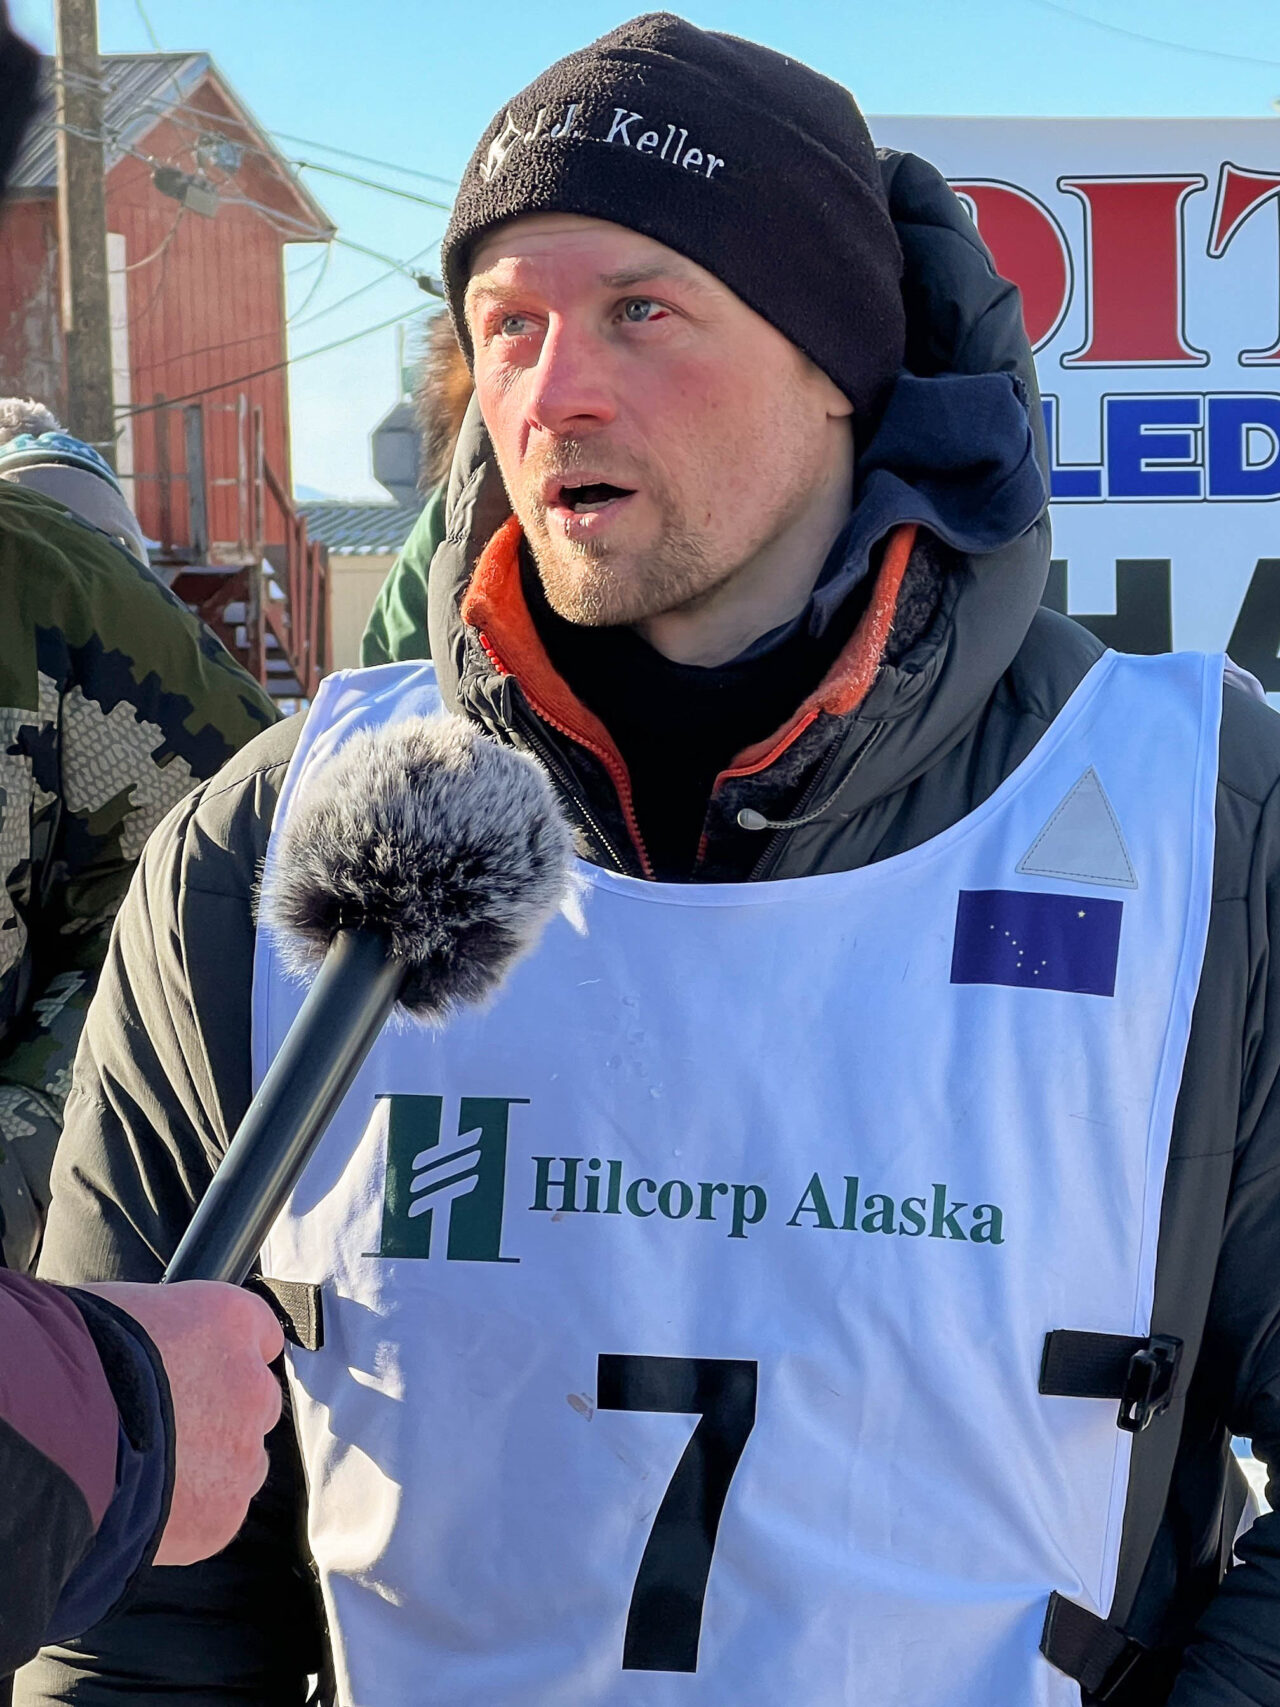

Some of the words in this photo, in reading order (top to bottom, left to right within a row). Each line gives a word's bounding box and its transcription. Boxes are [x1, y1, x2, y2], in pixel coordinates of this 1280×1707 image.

[603, 107, 725, 179] Keller
[528, 1155, 768, 1239] Hilcorp
[786, 1171, 1006, 1245] Alaska
[596, 1353, 759, 1674] 7
